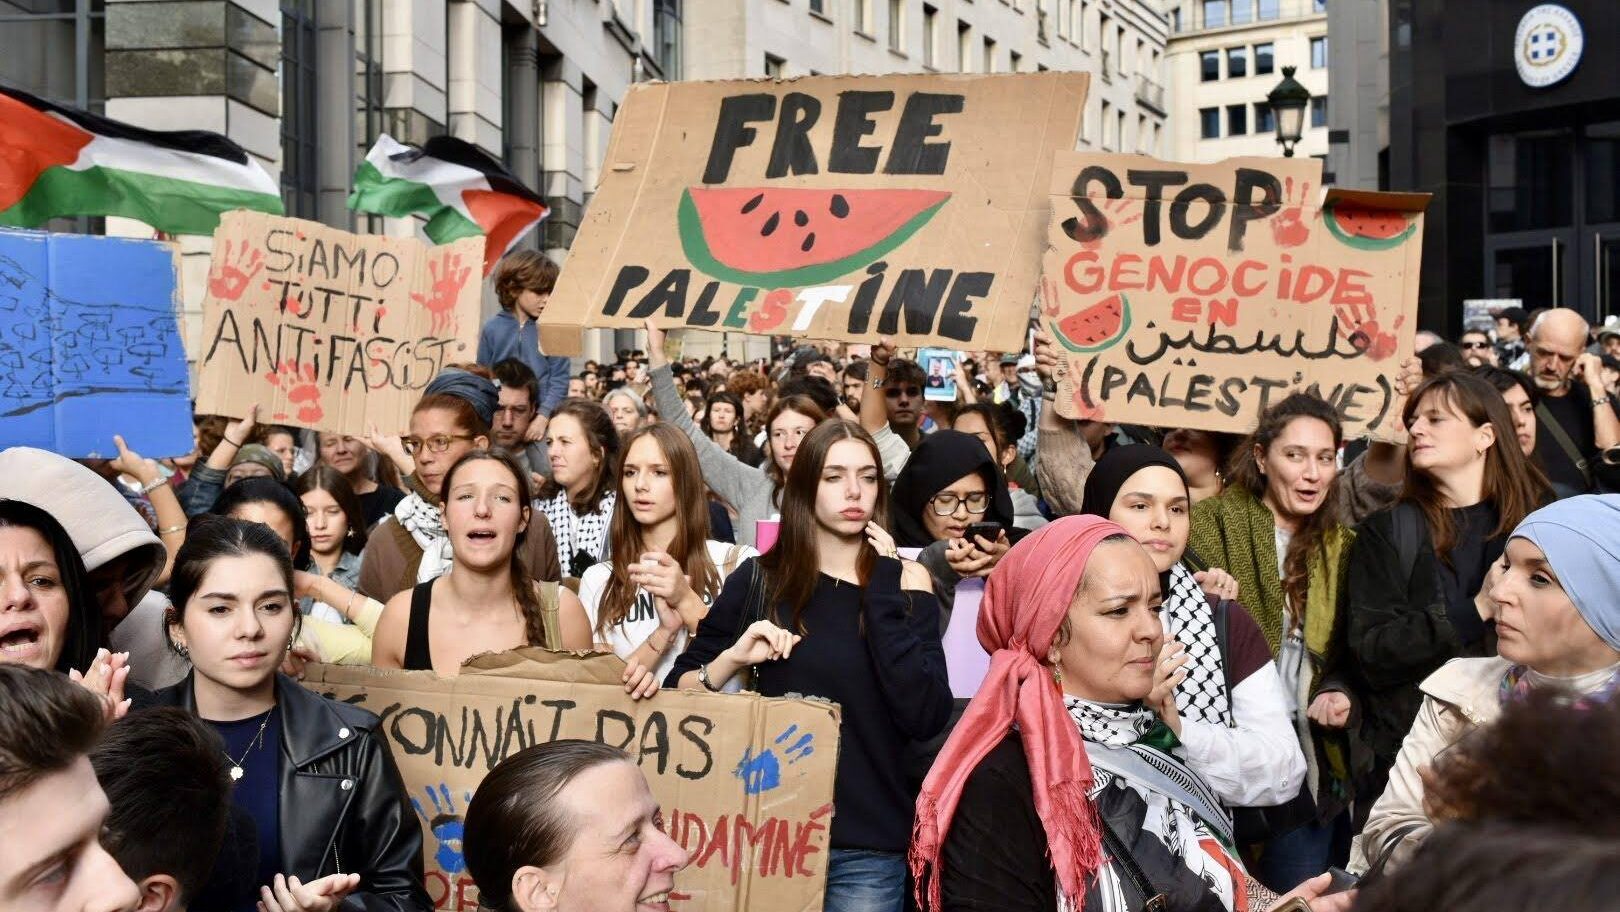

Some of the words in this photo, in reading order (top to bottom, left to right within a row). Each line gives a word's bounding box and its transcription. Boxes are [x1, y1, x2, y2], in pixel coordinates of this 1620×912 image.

[702, 90, 965, 185] FREE
[1061, 165, 1283, 253] STOP
[1125, 315, 1371, 367] فلسطين
[1171, 297, 1239, 326] EN
[203, 308, 467, 393] ANTiFASCiST
[1080, 354, 1392, 431] (PALESTE)
[594, 709, 716, 781] PAS
